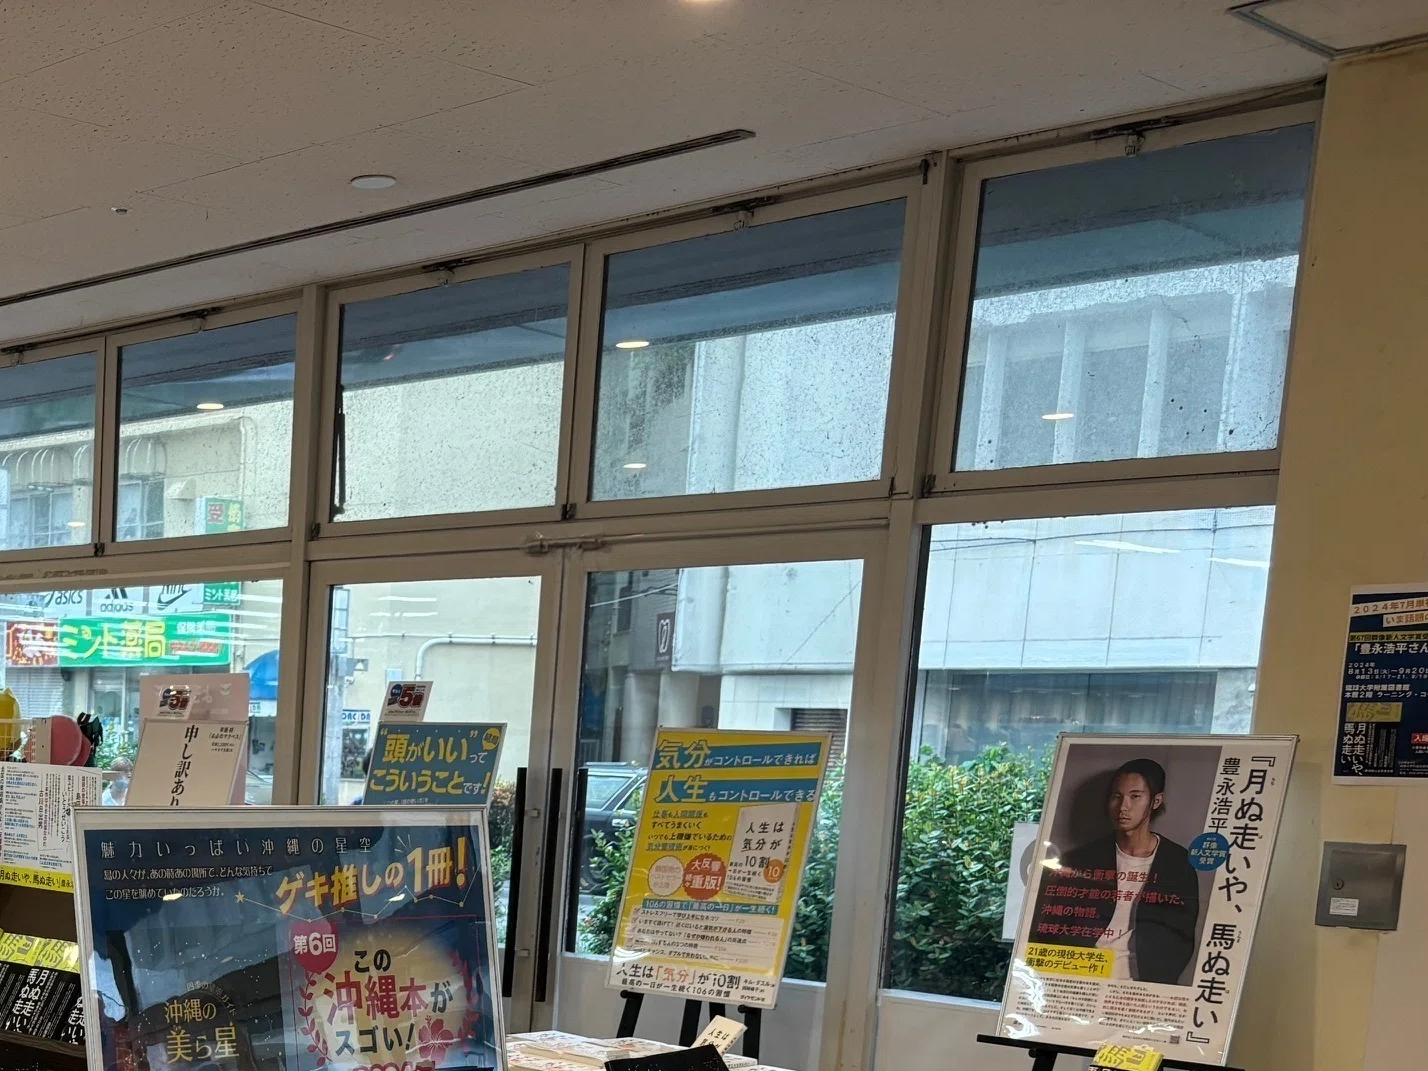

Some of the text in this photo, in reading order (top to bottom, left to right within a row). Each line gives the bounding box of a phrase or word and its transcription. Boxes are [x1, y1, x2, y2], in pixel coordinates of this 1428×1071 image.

[100, 602, 134, 613] adidas
[61, 620, 167, 660] ミント薬局
[655, 739, 818, 770] 気分がコントロールできれば
[1340, 723, 1355, 764] 馬ぬ走い
[654, 774, 816, 803] 人生もコントロールできる
[1208, 757, 1241, 834] 豊永浩平
[651, 821, 701, 830] すべてうまくいく
[745, 821, 784, 834] 人生は
[101, 836, 372, 859] 魅力いっぱい沖縄の星空
[741, 838, 783, 852] 気分が
[275, 837, 468, 916] ゲキ推しの1冊!
[691, 858, 721, 872] 大反響
[691, 874, 722, 891] 重版!
[1044, 885, 1185, 905] 圧倒的才能の若者が描いた、
[1041, 903, 1101, 919] 沖縄の物語。
[1037, 922, 1122, 940] 琉球大学在学中!
[293, 932, 338, 957] 第6回
[1027, 946, 1108, 964] 21歳の現役大学生、
[353, 948, 392, 974] この
[1026, 957, 1105, 975] 衝撃のデビュー作!
[164, 998, 217, 1024] 沖縄の
[322, 973, 454, 1026] 沖縄本が
[166, 1025, 240, 1064] 美ら星
[335, 1025, 414, 1058] スゴい!
